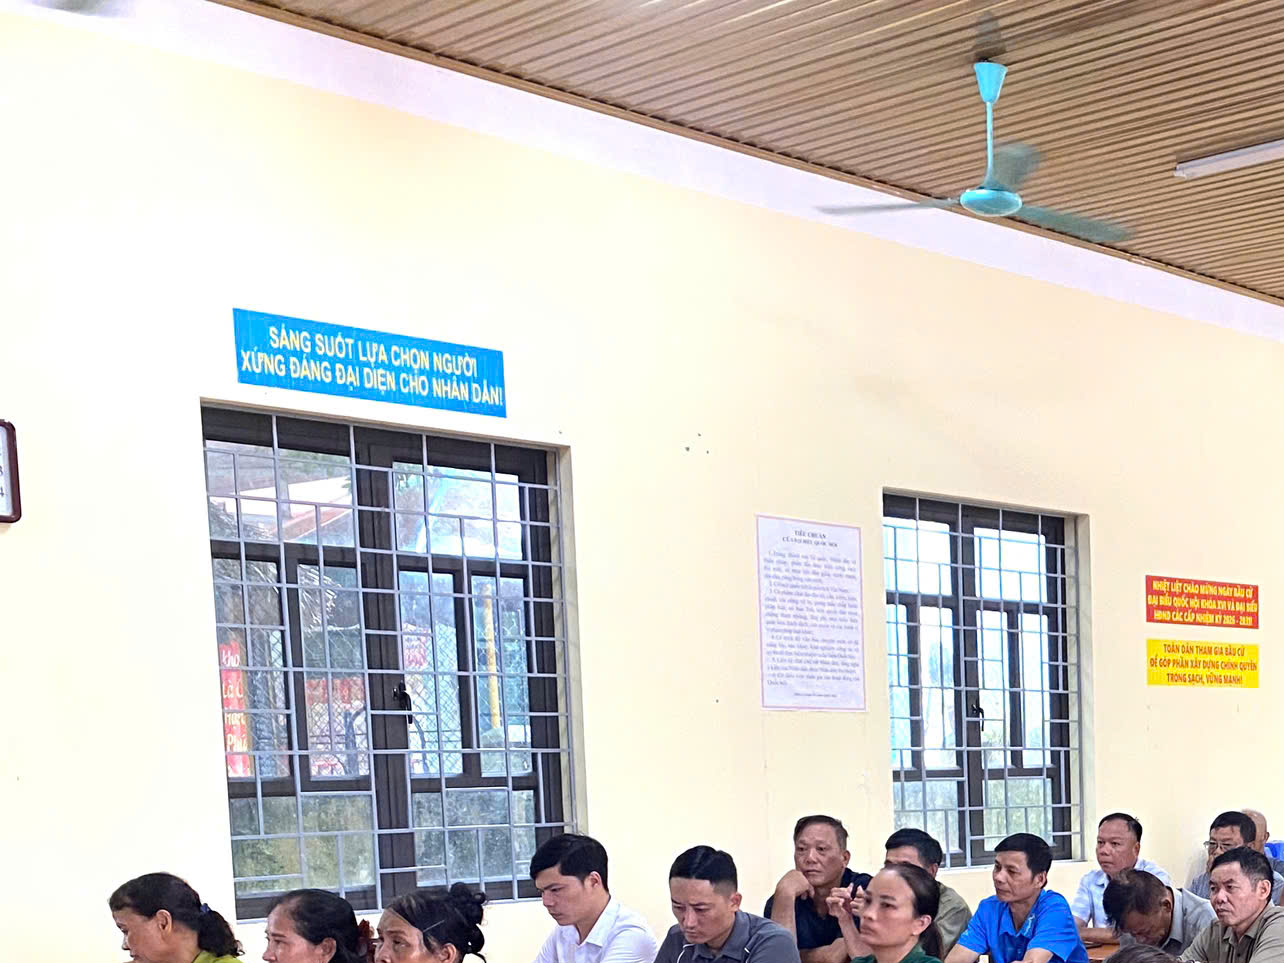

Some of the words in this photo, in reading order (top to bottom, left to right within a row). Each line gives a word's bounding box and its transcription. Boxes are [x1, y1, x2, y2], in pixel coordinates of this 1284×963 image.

[241, 346, 286, 377] XỨNG
[289, 354, 332, 383] ĐÁNG
[335, 362, 360, 391] ĐẠI
[363, 366, 396, 395] DIỆN
[400, 373, 429, 396] CHO
[432, 376, 469, 401] NHÂN
[472, 380, 503, 406] DÂN!
[269, 323, 311, 352] SÁNG
[315, 332, 354, 359] SUỐT
[358, 340, 388, 368] LỰA
[391, 345, 430, 373] CHỌN
[433, 352, 478, 378] NGƯỜI
